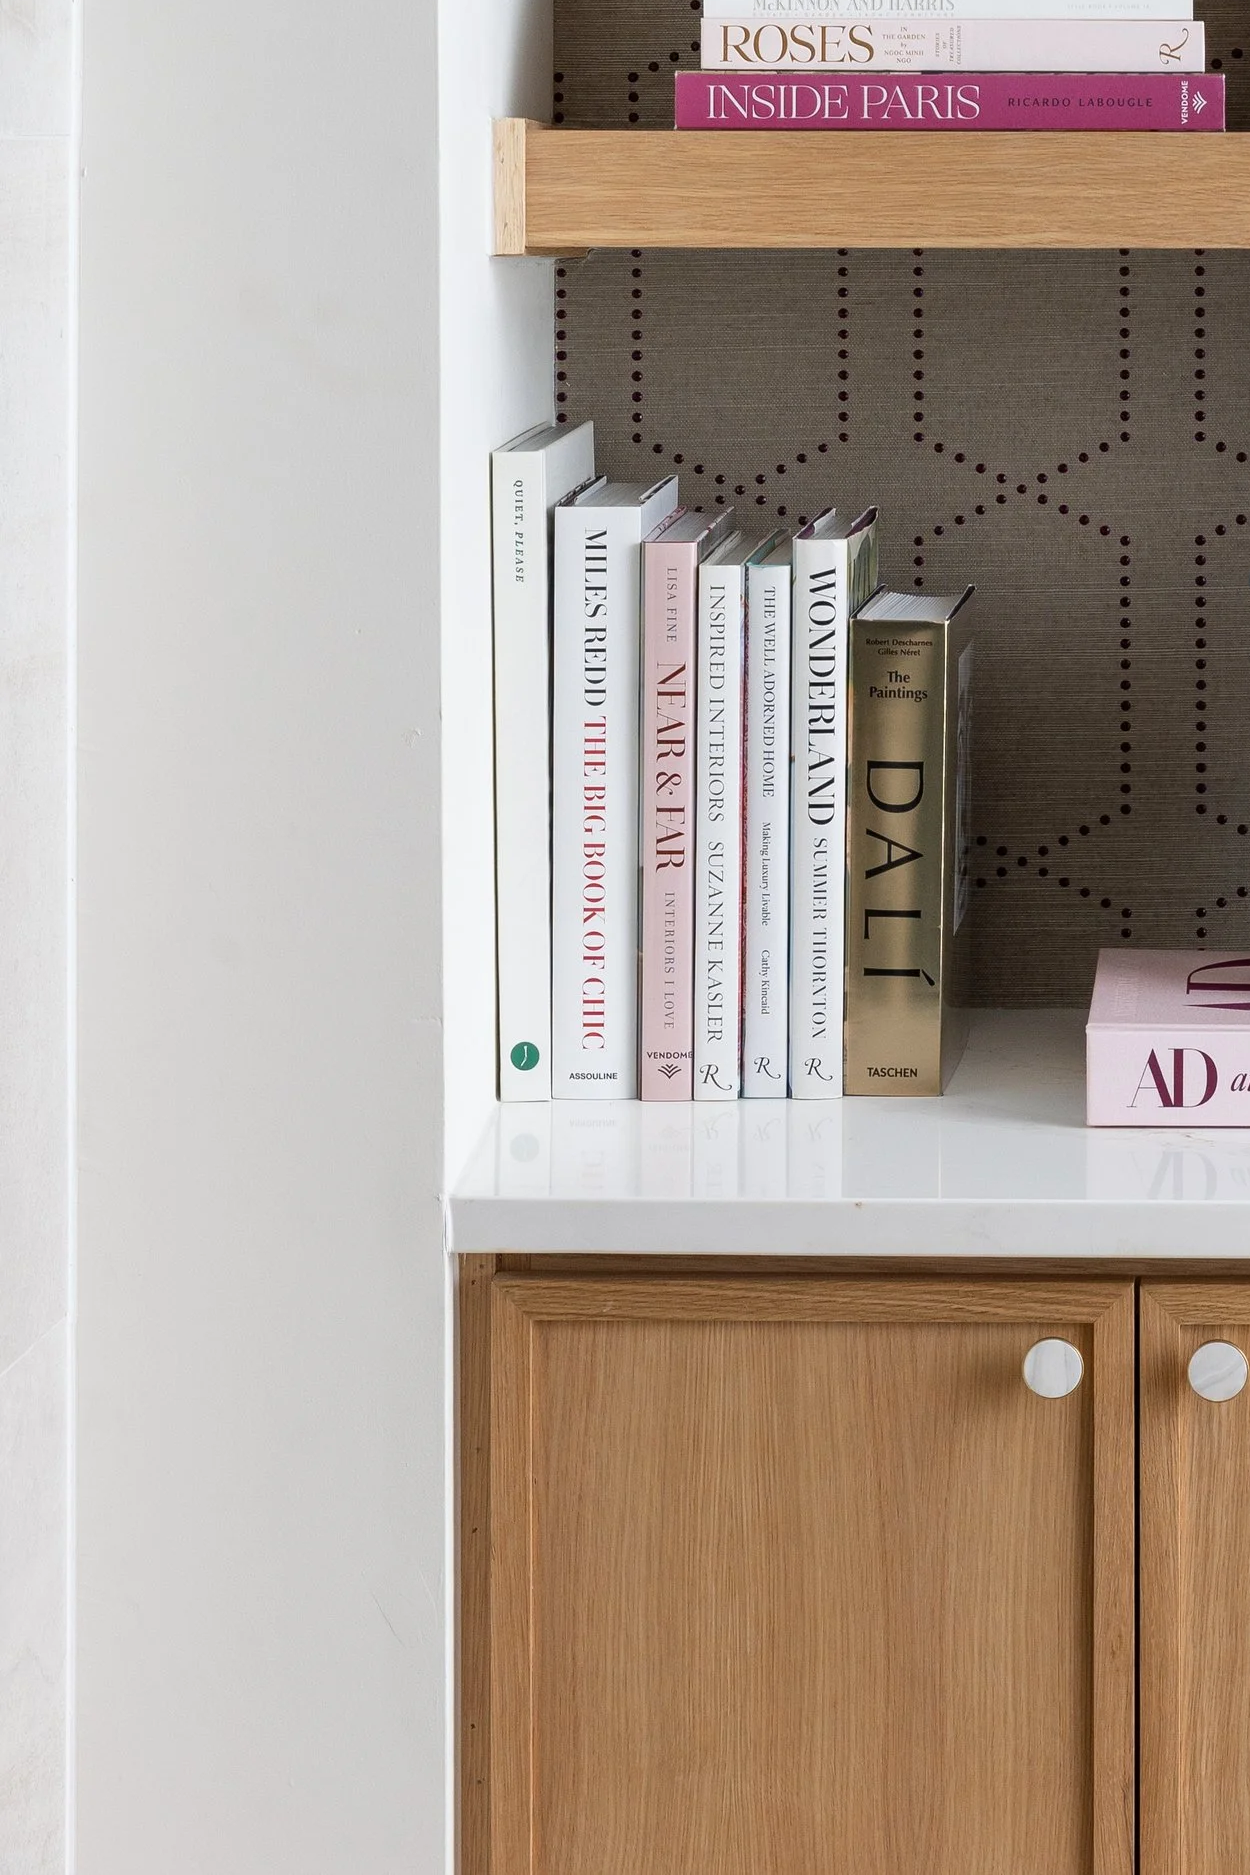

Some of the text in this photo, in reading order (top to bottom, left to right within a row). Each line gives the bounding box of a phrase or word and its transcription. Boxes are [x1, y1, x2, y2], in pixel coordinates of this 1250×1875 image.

[719, 24, 875, 64] ROSES
[706, 84, 981, 120] INSIDE PARIS
[1007, 97, 1153, 107] RICARDO LABOUGLE
[1181, 80, 1189, 125] VENDOME
[513, 479, 525, 583] QUIET, PLEASE
[666, 567, 678, 643] LISA FINE
[877, 648, 921, 656] Gilles Néret
[892, 638, 933, 646] Descharnes
[762, 586, 776, 798] THE WELL ADORNED HOME
[869, 686, 928, 703] Paintings
[887, 670, 911, 683] The
[581, 527, 608, 1050] MILES REDD THE BIG BOOK OF CHIC
[655, 661, 687, 873] NEAR & FAR
[707, 585, 726, 1044] INSPIRED INTERIORS SUZANNE KASLER
[807, 565, 837, 1039] WONDERLAND SUMMER THORNTON
[759, 822, 771, 926] Making Luxury Livable
[863, 759, 936, 987] DALÍ
[664, 892, 675, 974] INTERIORS
[759, 949, 771, 1015] Cathy Kincaid
[663, 993, 675, 1030] LOVE
[568, 1072, 618, 1081] ASSOULINE
[646, 1051, 693, 1060] VENDOME
[867, 1067, 918, 1079] TASCHEN
[1126, 1047, 1219, 1108] AD
